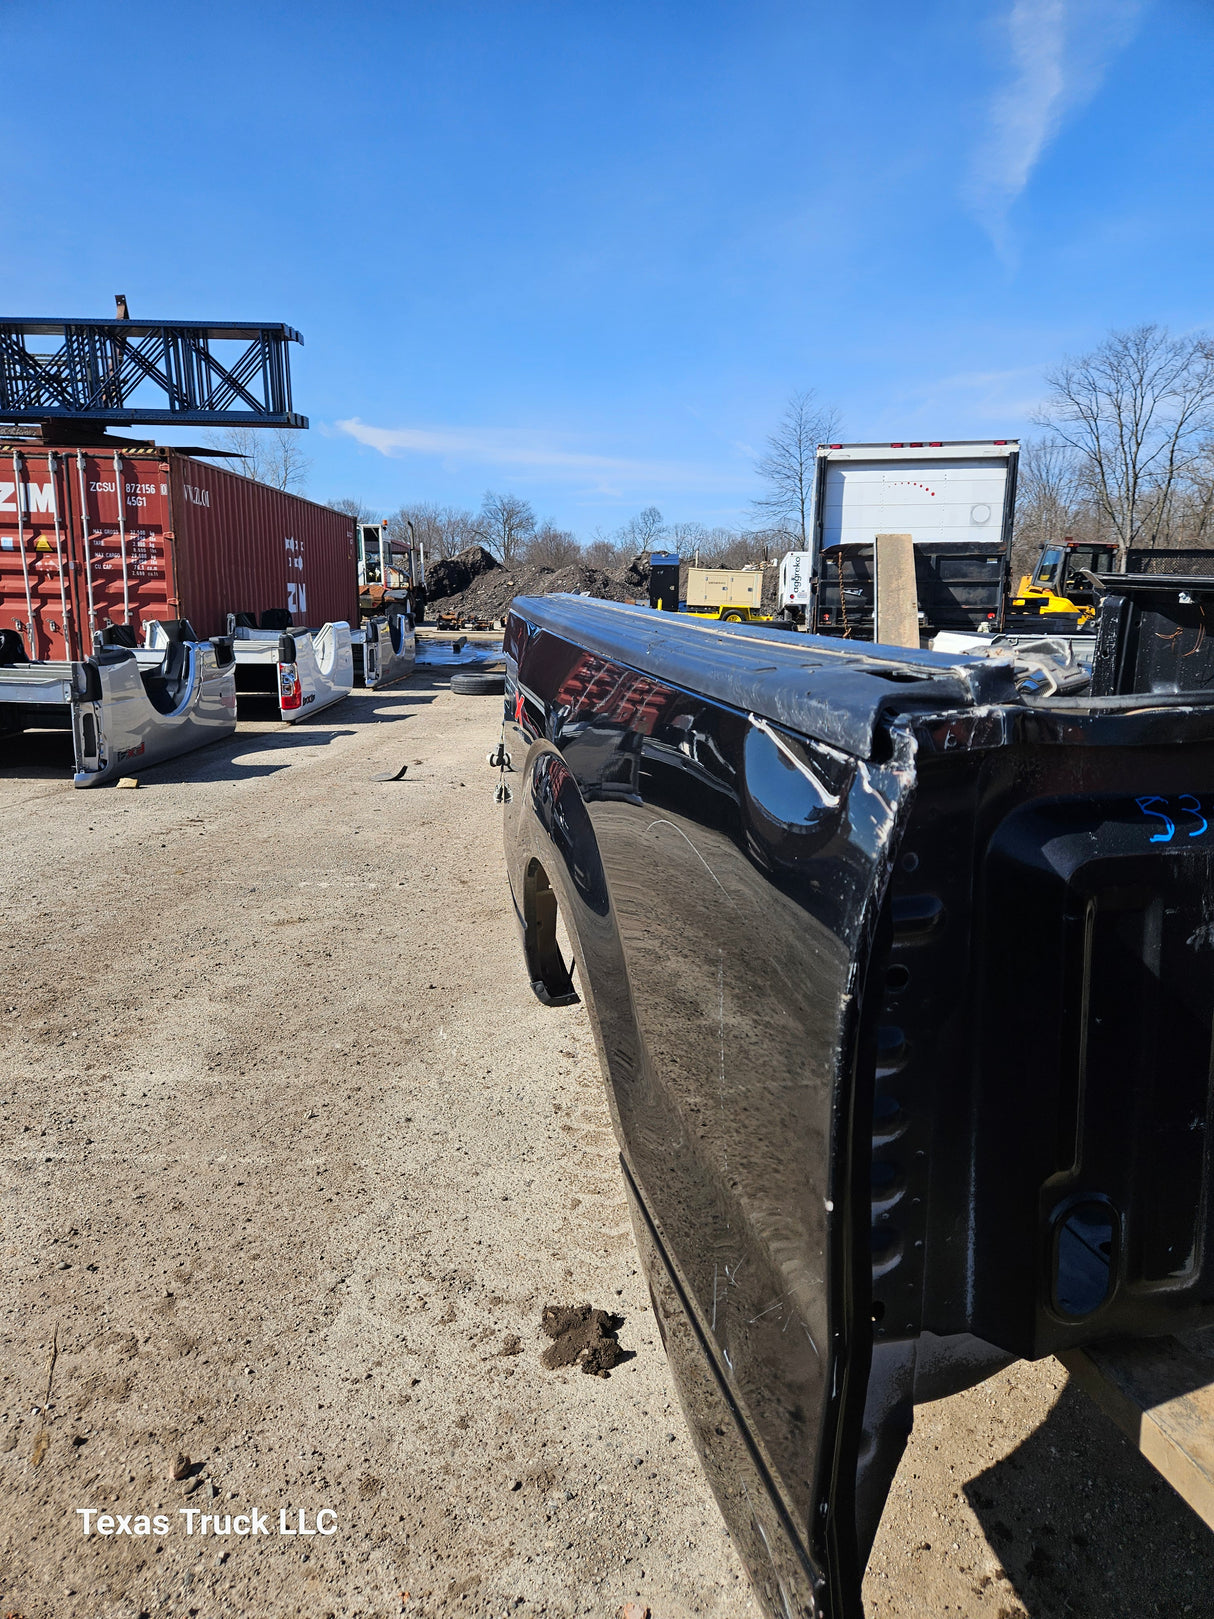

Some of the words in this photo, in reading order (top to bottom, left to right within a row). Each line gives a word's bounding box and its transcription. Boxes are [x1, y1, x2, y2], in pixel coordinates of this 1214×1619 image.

[89, 481, 116, 492] ZCSU
[125, 483, 156, 494] 872156
[0, 482, 56, 513] ZIM
[126, 496, 147, 507] 45G1
